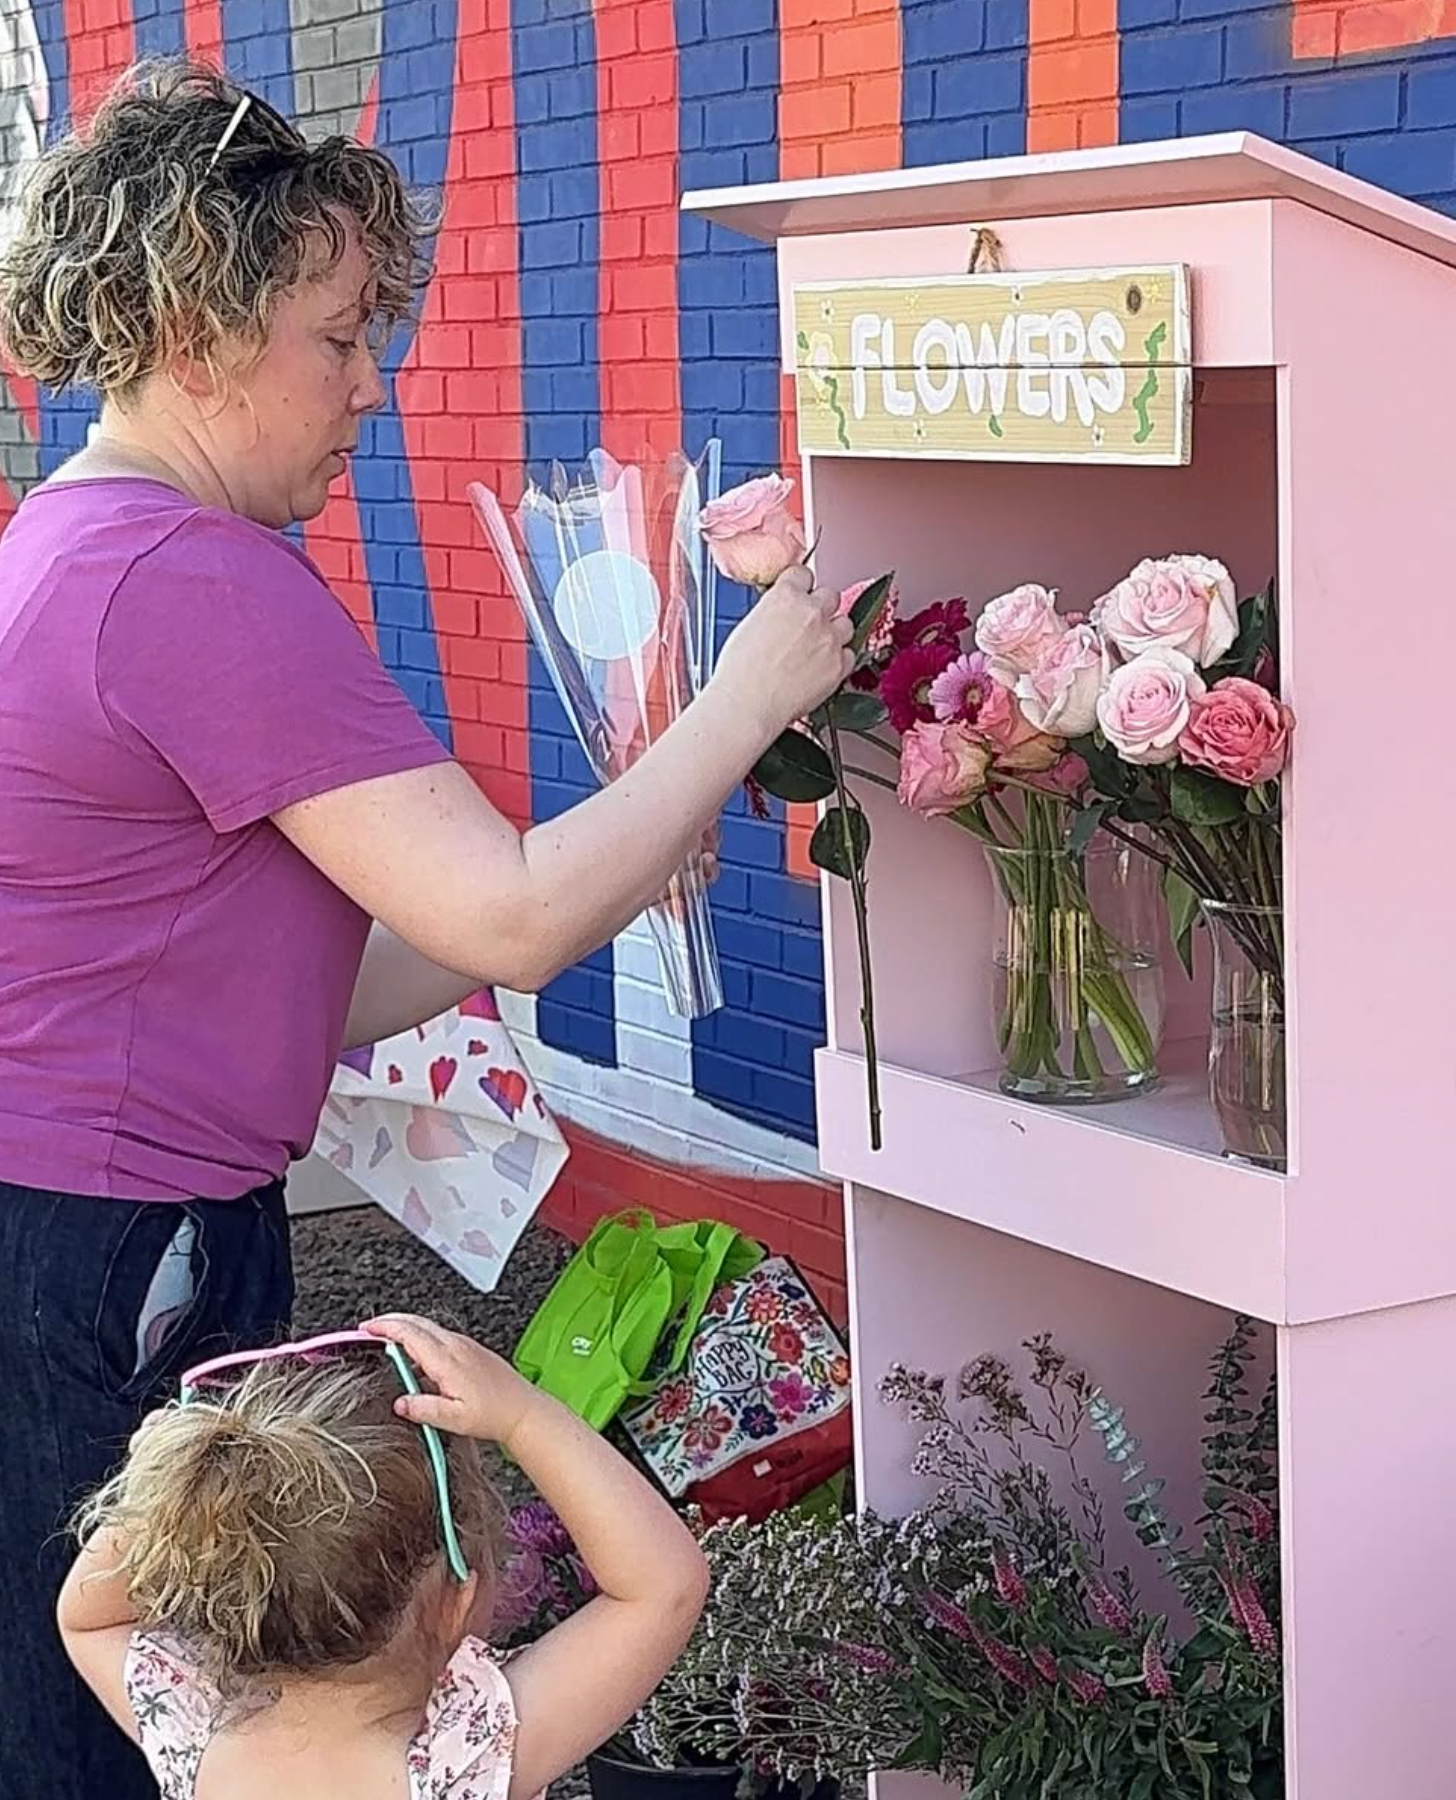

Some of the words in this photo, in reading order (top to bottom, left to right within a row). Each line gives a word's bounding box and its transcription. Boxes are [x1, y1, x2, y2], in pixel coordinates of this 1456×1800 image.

[850, 309, 1126, 426] FLOWERS
[696, 1340, 750, 1379] HAPPY
[711, 1361, 753, 1387] BAG
